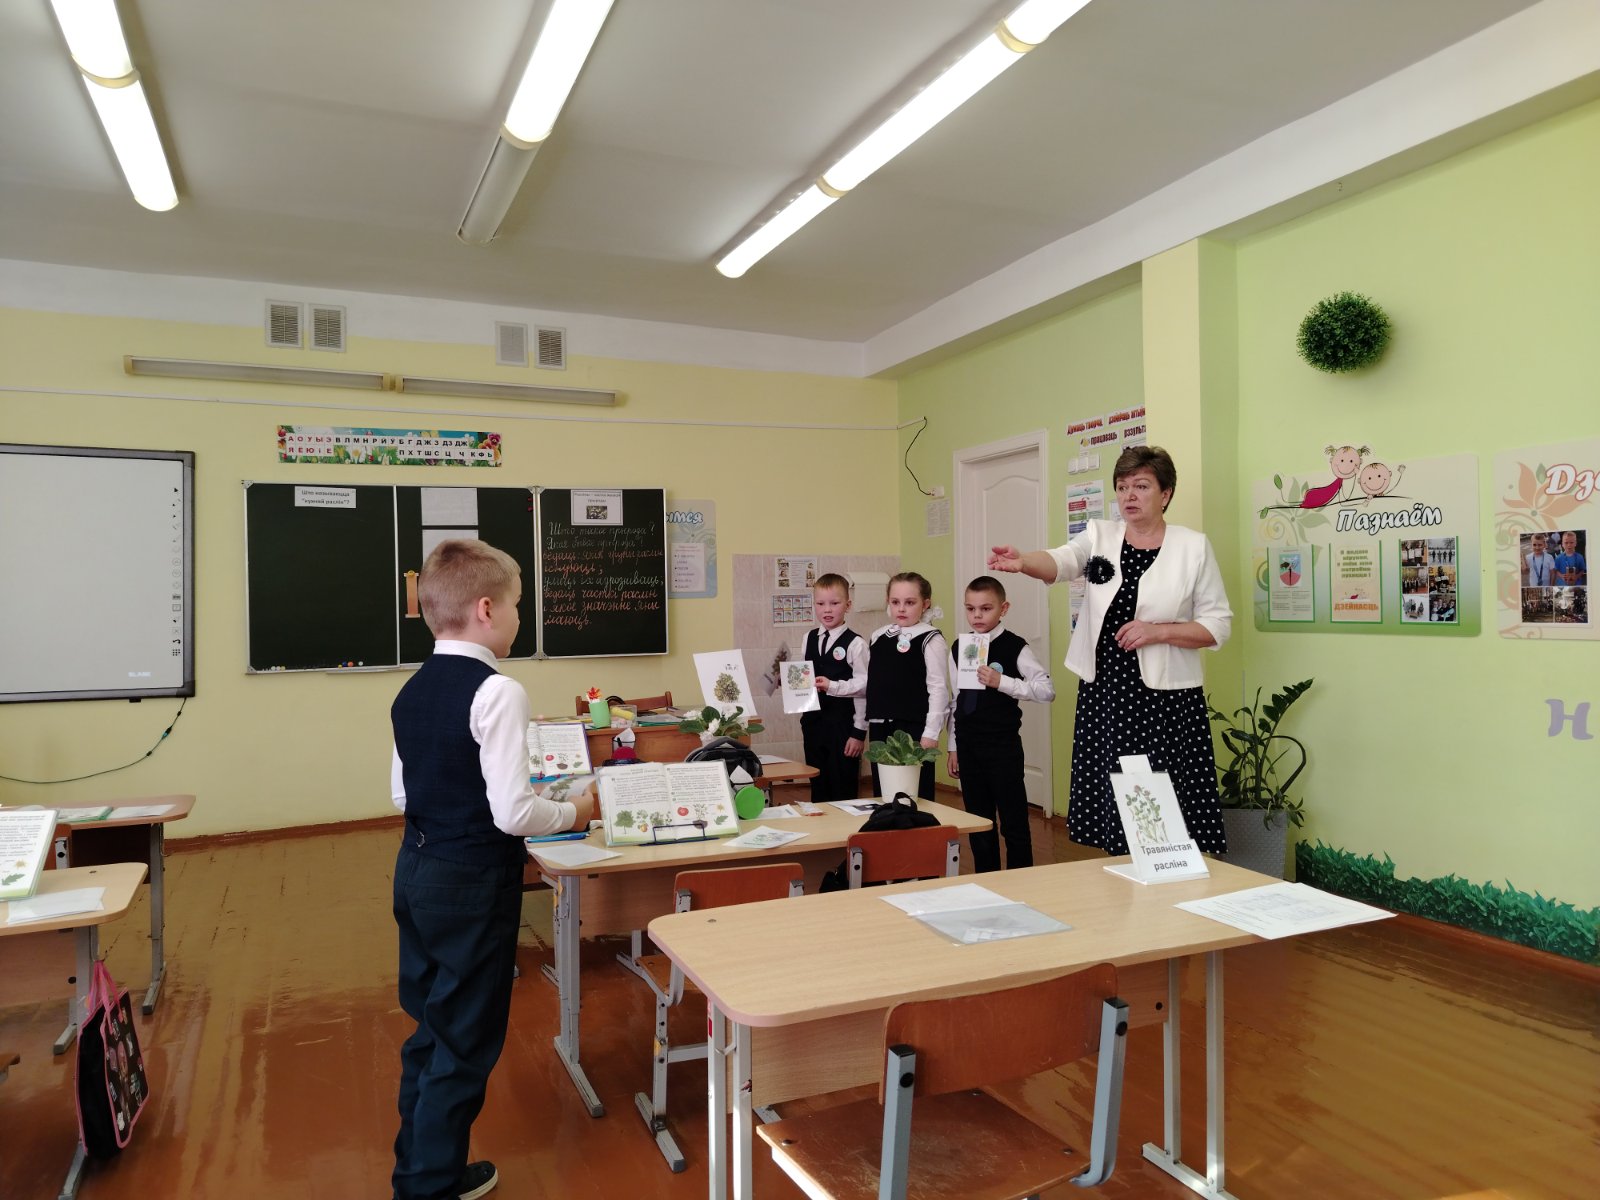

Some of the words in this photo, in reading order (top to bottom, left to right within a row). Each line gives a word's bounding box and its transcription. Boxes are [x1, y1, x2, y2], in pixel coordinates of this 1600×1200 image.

[1336, 502, 1442, 536] Пазнаём
[1141, 842, 1193, 856] Травяністая
[1153, 860, 1188, 872] расліна
